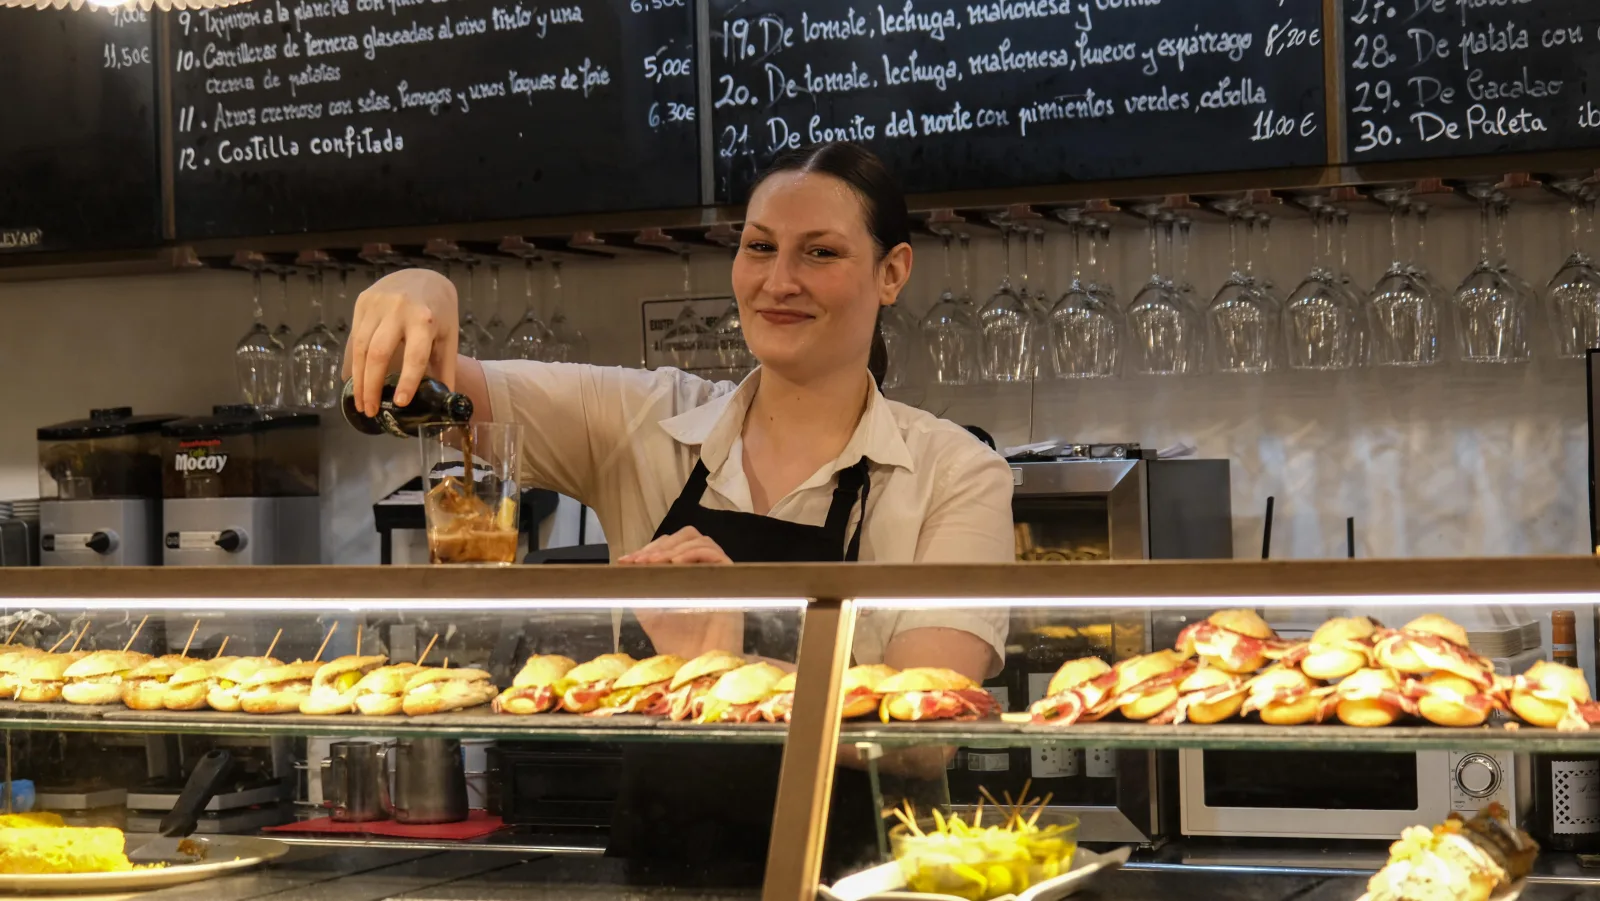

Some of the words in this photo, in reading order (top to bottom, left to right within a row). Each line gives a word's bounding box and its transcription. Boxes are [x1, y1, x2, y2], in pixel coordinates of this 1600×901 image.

[177, 49, 200, 72] 10.
[203, 42, 277, 69] Carrilleras
[283, 32, 300, 58] de
[304, 31, 359, 57] ternera
[363, 20, 434, 61] glaseadas
[438, 15, 454, 39] al
[455, 15, 487, 36] vino
[492, 5, 533, 31] tinto
[536, 13, 548, 39] y
[550, 5, 583, 24] una
[178, 11, 198, 36] 9.
[263, 8, 273, 25] a
[276, 0, 289, 22] la
[722, 18, 756, 60] 19.
[759, 16, 794, 52] De
[801, 8, 876, 43] tomate,
[877, 0, 962, 41] lechuga,
[1075, 3, 1092, 31] y
[714, 74, 759, 109] 20.
[764, 62, 799, 102] De
[805, 61, 878, 94] tomate,
[882, 49, 963, 91] lechuga,
[967, 37, 1077, 76] mahonesa,
[1075, 31, 1136, 68] huevo
[1141, 47, 1158, 75] y
[1157, 24, 1252, 71] espárrago
[1352, 34, 1397, 70] 28.
[1407, 28, 1450, 67] De
[1459, 21, 1529, 70] patata
[1541, 25, 1584, 49] con
[205, 76, 255, 94] crema
[263, 68, 281, 89] de
[288, 62, 341, 97] patatas
[643, 56, 691, 83] 5,00€
[260, 102, 323, 123] cremoso
[328, 98, 354, 116] con
[456, 91, 470, 113] y
[468, 82, 506, 98] unos
[560, 67, 579, 90] de
[1352, 80, 1400, 114] 29.
[1407, 76, 1456, 108] De
[766, 116, 801, 152] De
[885, 109, 918, 138] del
[920, 101, 973, 134] norte
[975, 107, 1009, 127] con
[1019, 89, 1115, 136] pimientos
[1354, 120, 1401, 152] 30.
[1410, 111, 1461, 142] De
[1466, 103, 1548, 140] Paleta
[218, 135, 300, 164] Costilla
[310, 125, 404, 159] confitada
[0, 229, 39, 247] EVAR
[175, 453, 228, 474] Mocay
